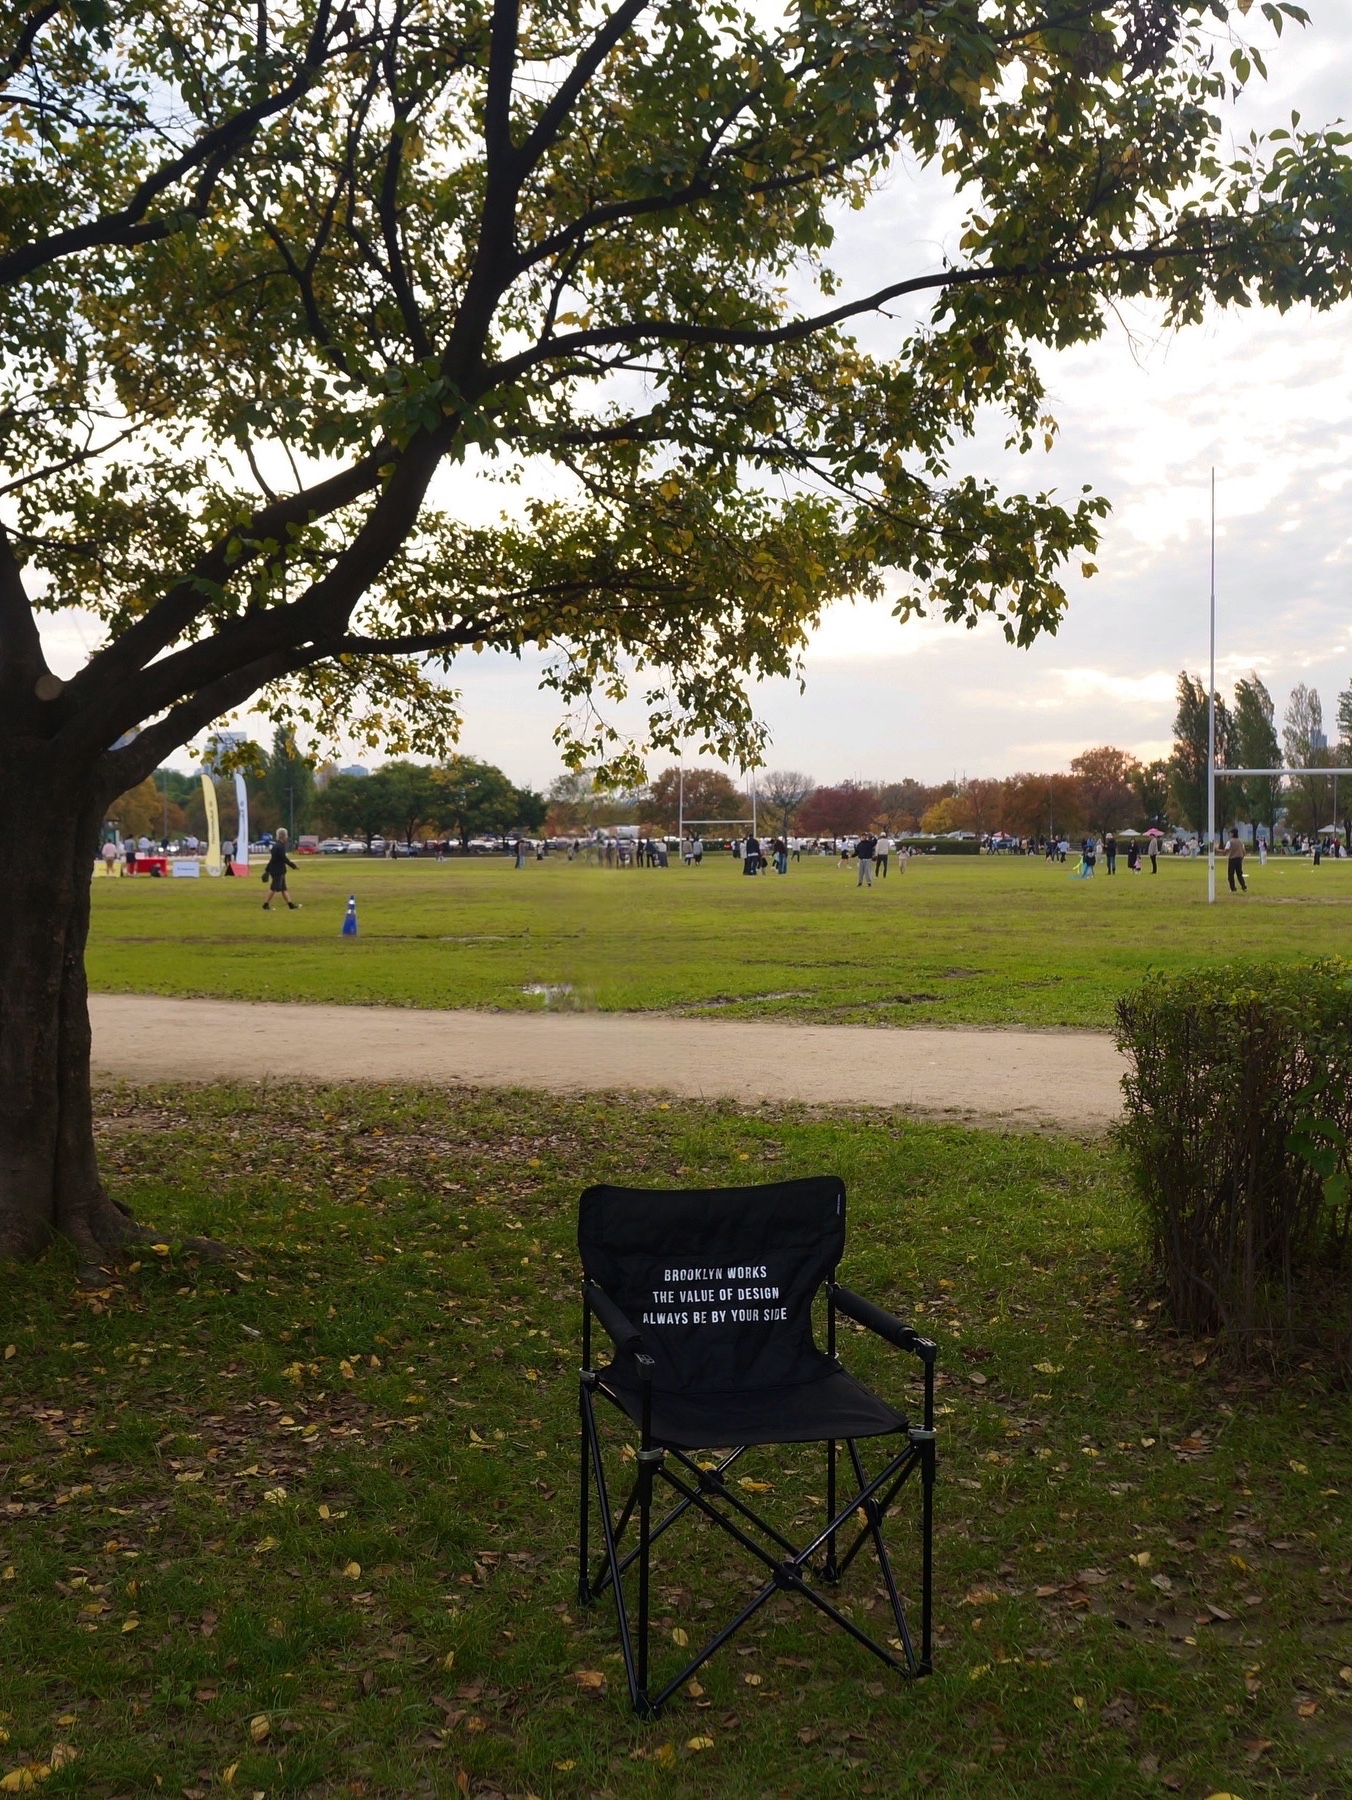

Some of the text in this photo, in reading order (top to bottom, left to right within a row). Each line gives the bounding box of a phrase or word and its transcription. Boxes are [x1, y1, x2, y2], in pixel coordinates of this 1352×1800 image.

[664, 1266, 766, 1281] BROOKLYN WORKS
[653, 1287, 779, 1303] THE VALUE OF DESIGN
[643, 1308, 787, 1324] ALWAYS BE BY YOUR SIDE
